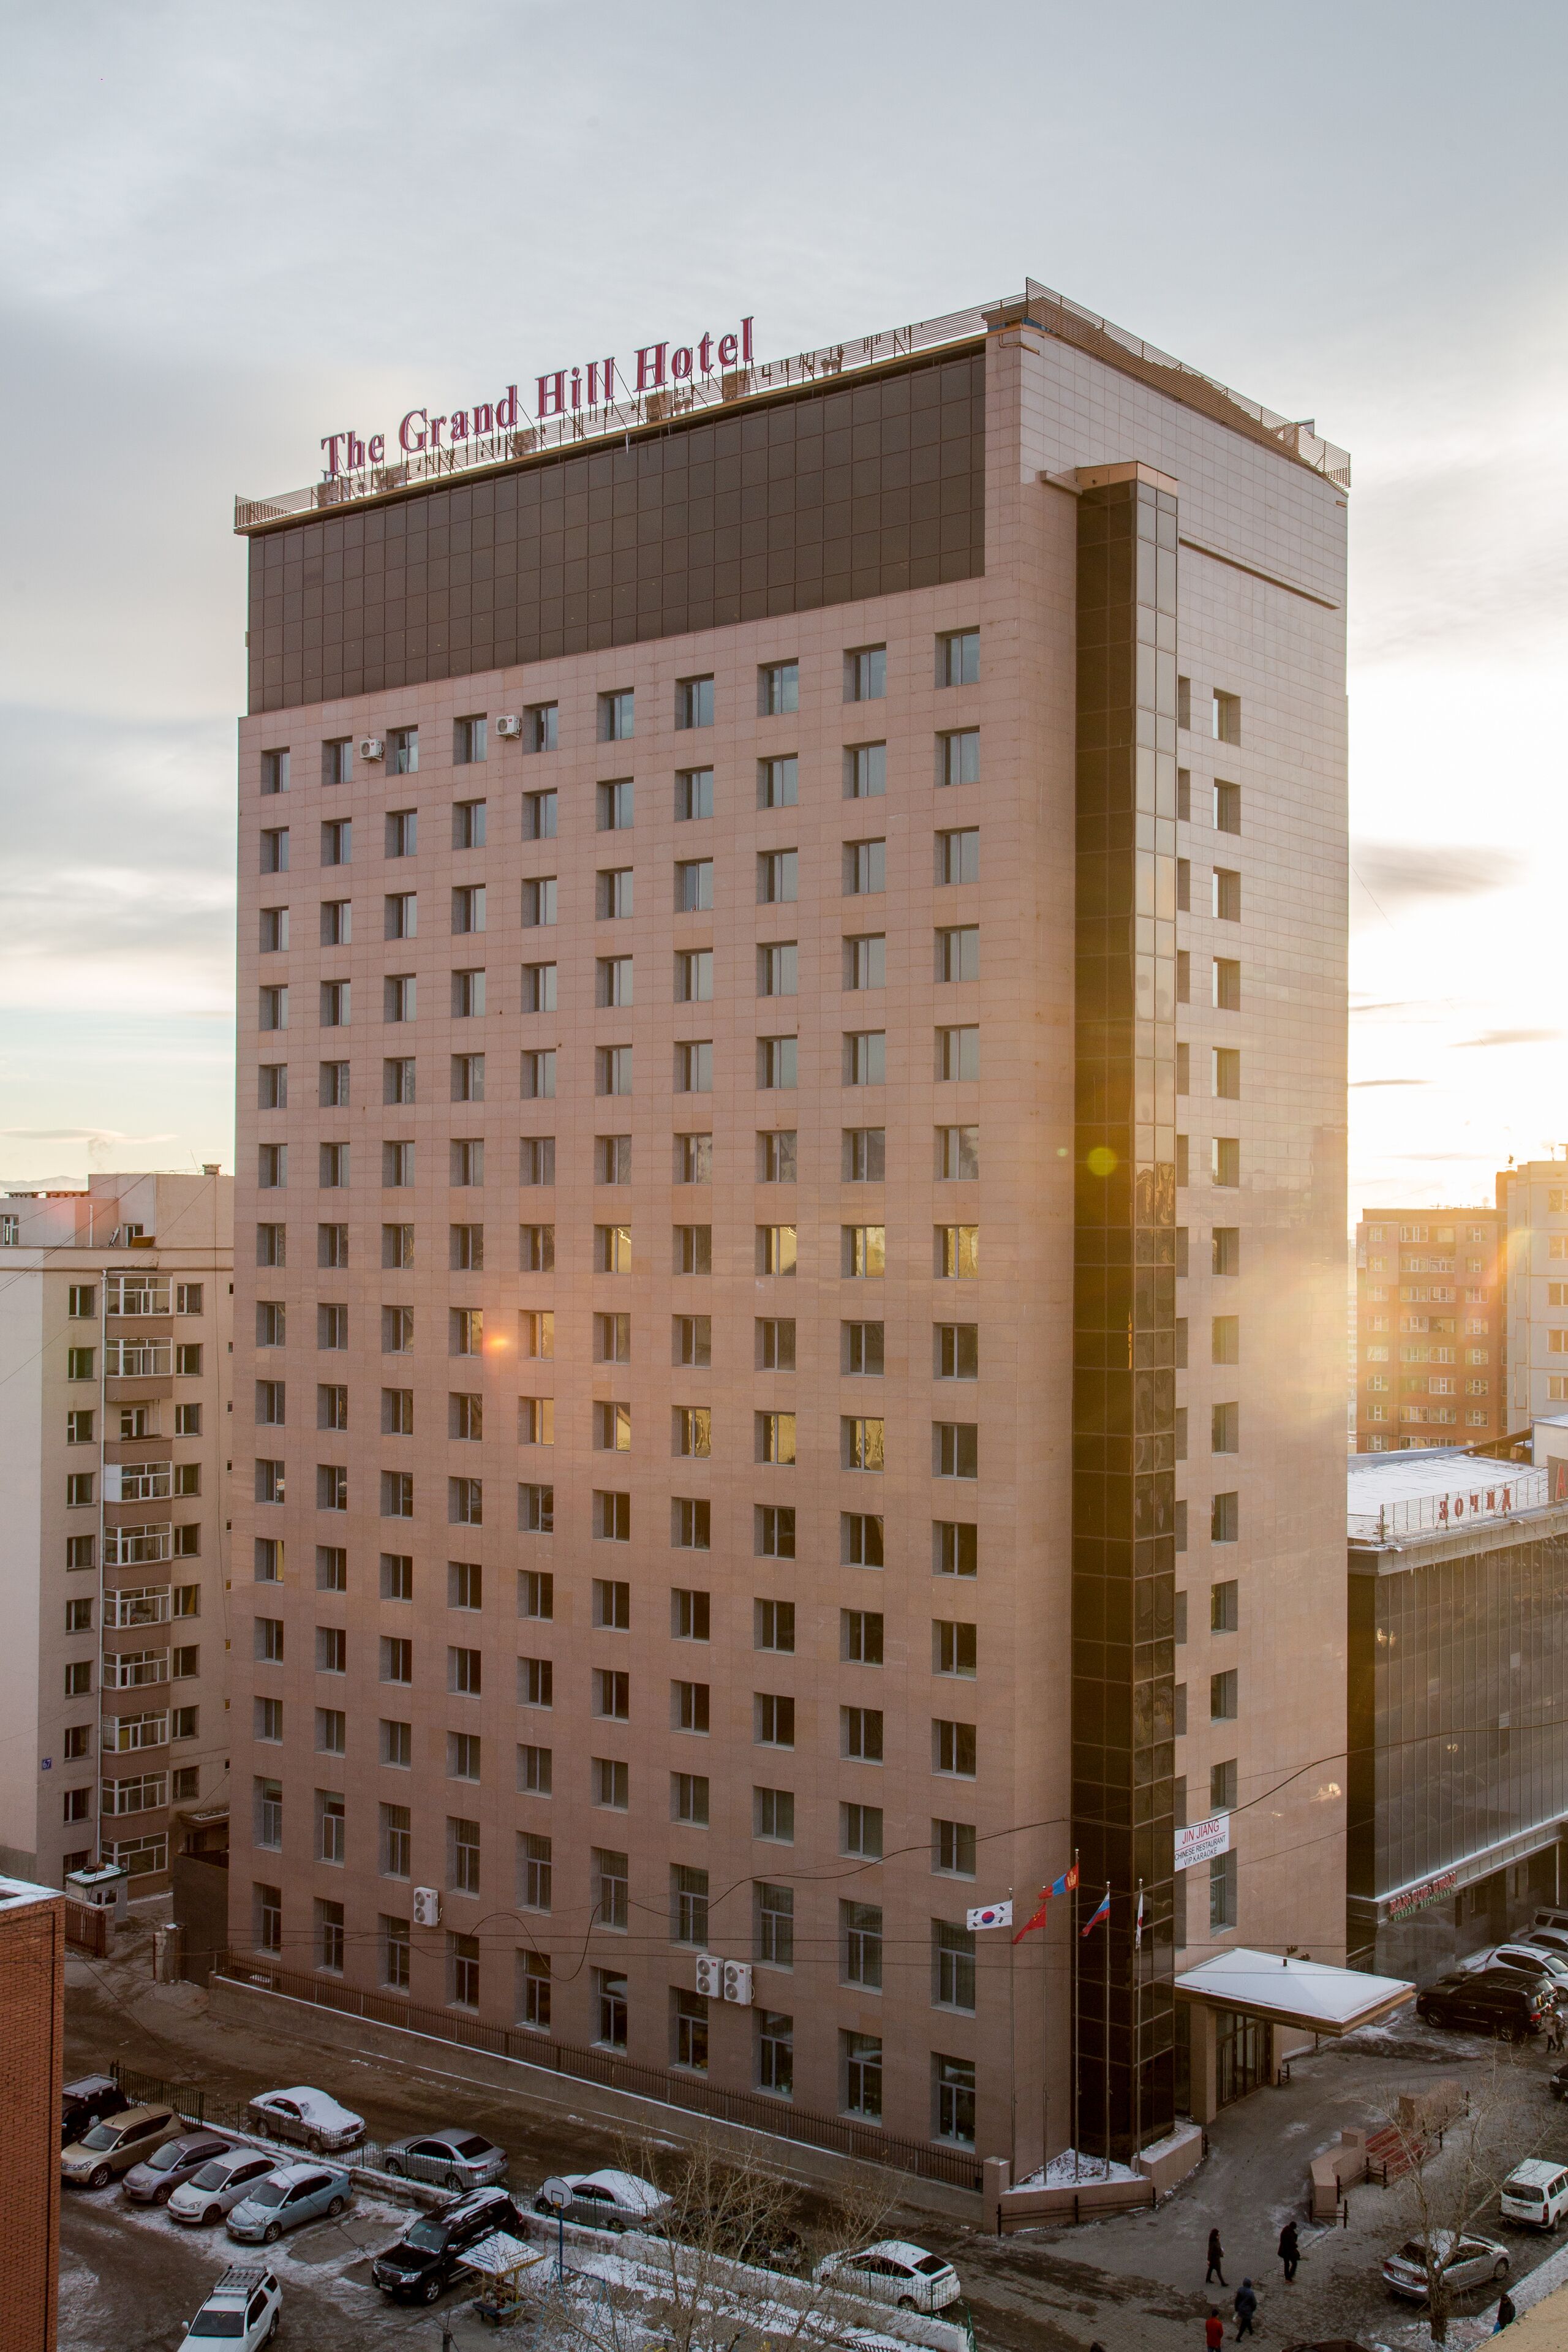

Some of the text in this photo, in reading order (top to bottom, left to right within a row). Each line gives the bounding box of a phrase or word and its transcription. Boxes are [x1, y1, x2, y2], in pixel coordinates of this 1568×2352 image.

[320, 315, 755, 476] The Grand Hill Hotel
[43, 1759, 51, 1768] 67
[1182, 1820, 1219, 1844] JIN JIANG
[1175, 1835, 1226, 1861] CHINESE RESTAURANT
[1183, 1847, 1218, 1866] VIP KARAOKE
[1393, 1887, 1455, 1921] KOREAN RESTAURANT
